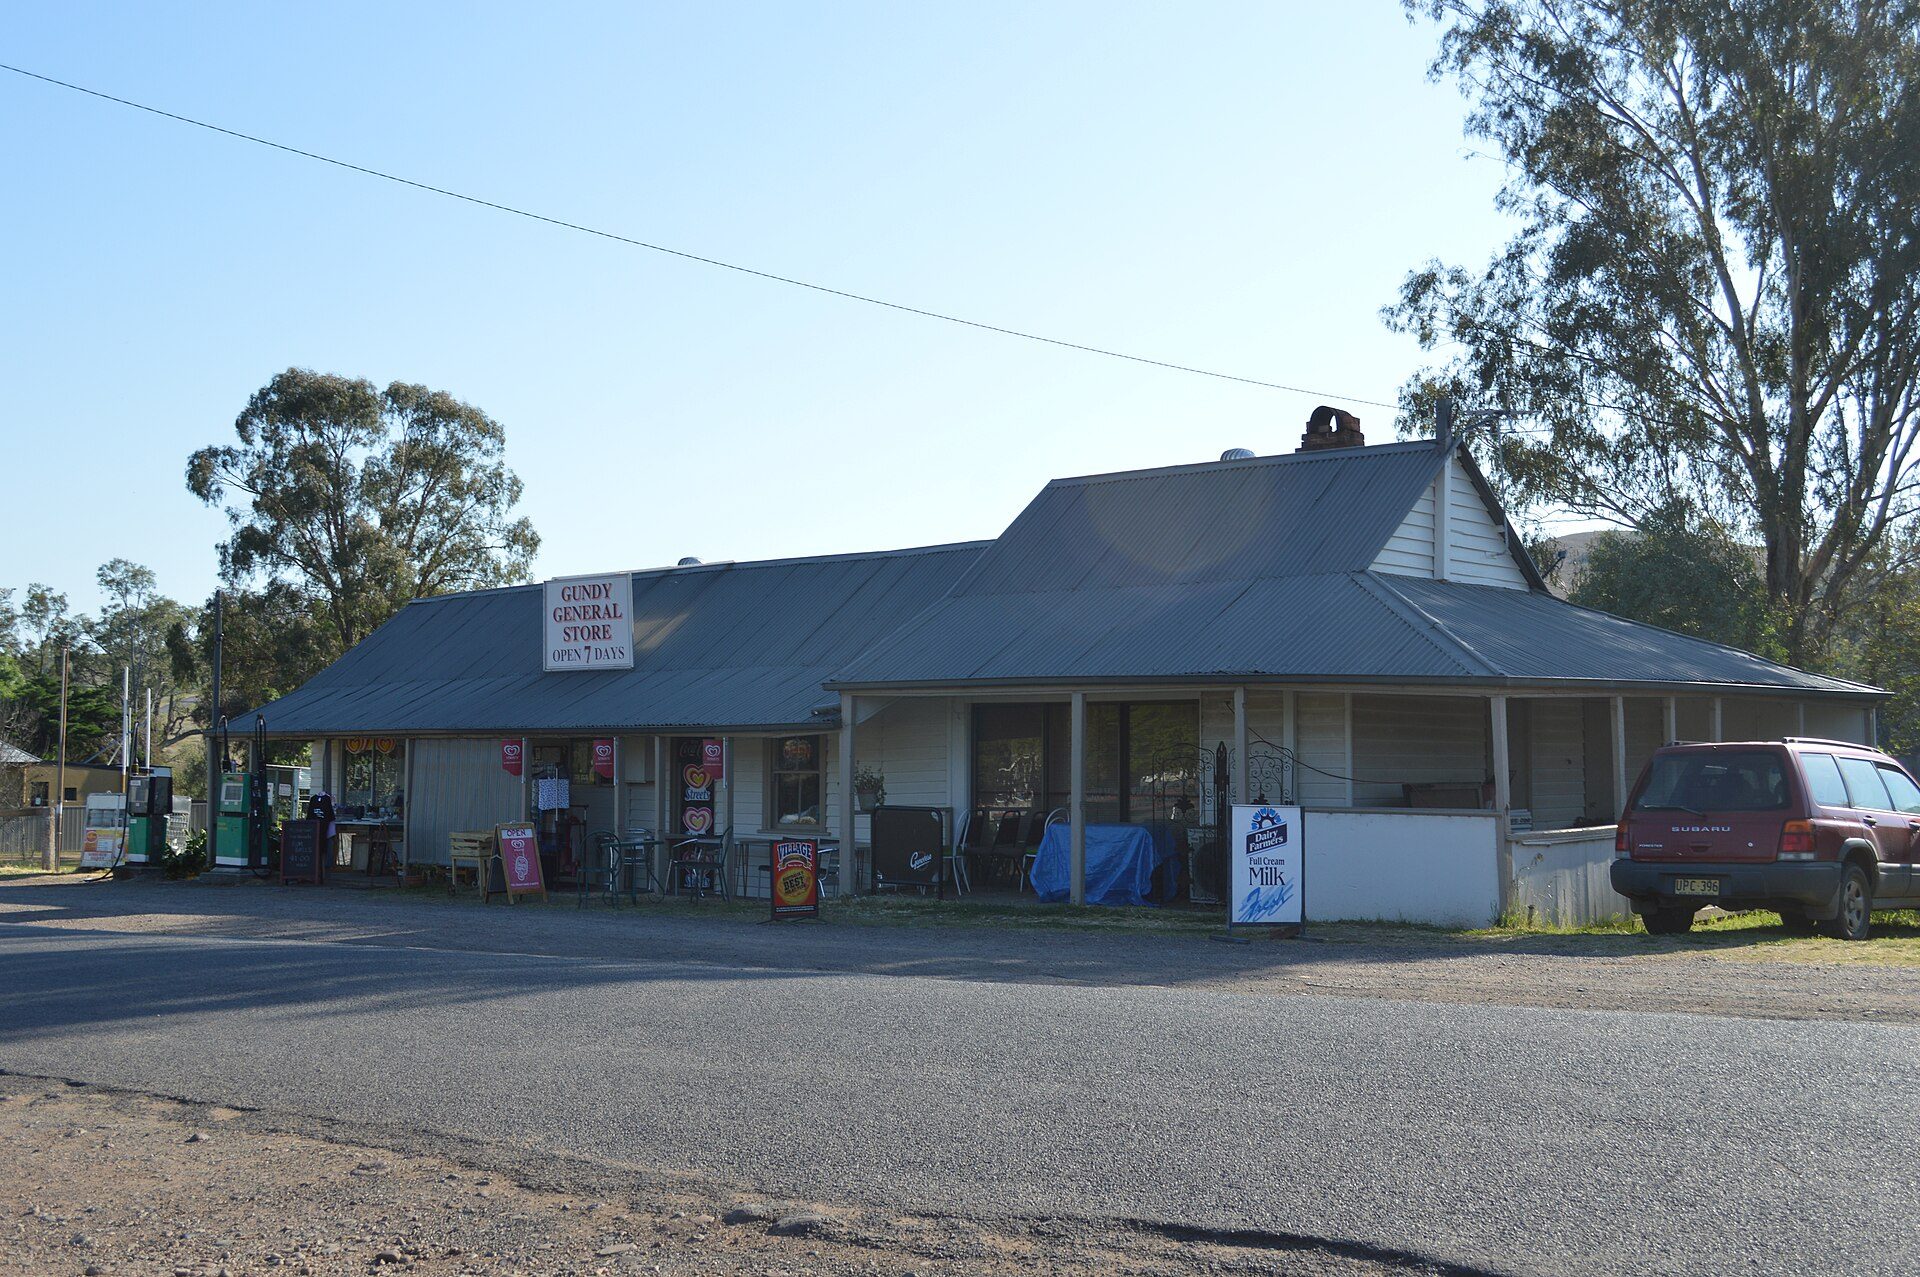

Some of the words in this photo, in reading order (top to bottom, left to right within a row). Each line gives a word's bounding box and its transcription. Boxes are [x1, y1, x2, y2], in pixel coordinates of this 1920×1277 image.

[561, 583, 612, 602] GUNDY
[553, 603, 623, 623] GENERAL
[563, 624, 612, 642] STORE
[552, 648, 581, 662] OPEN
[584, 645, 591, 664] 7
[594, 646, 625, 660] DAYS
[684, 788, 711, 800] Streets
[506, 828, 526, 837] OPEN
[1255, 829, 1278, 842] Dairy
[777, 842, 813, 862] VILLAGE
[1249, 837, 1283, 852] Farmers
[1249, 857, 1262, 865] Full
[1263, 857, 1285, 866] Cream
[783, 876, 805, 891] BEST
[1249, 866, 1286, 886] Milk
